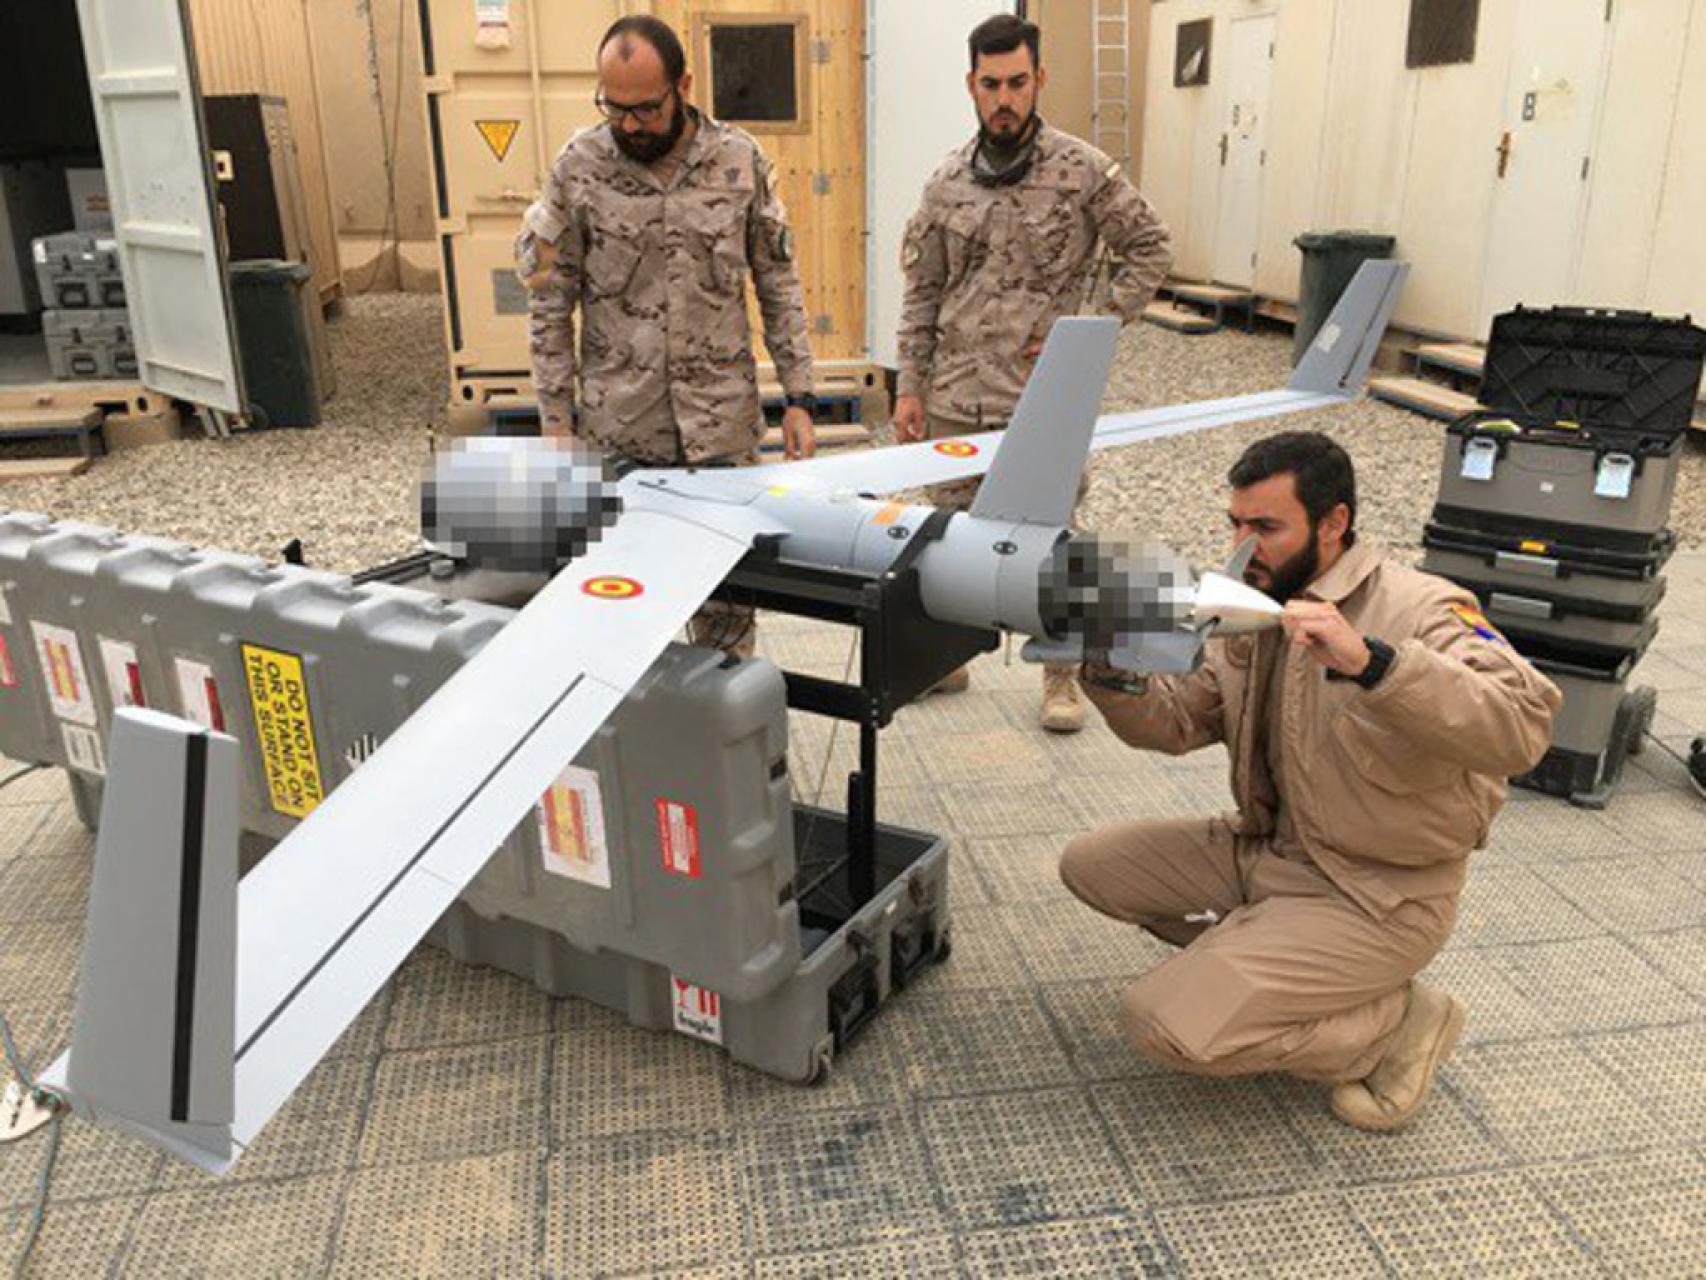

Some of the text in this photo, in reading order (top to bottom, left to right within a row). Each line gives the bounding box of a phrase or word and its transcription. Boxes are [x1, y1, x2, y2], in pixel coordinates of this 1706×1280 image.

[249, 655, 289, 806] THIS SURFACE
[267, 661, 304, 808] OR STAND ON
[285, 679, 321, 800] DO NOT SIT
